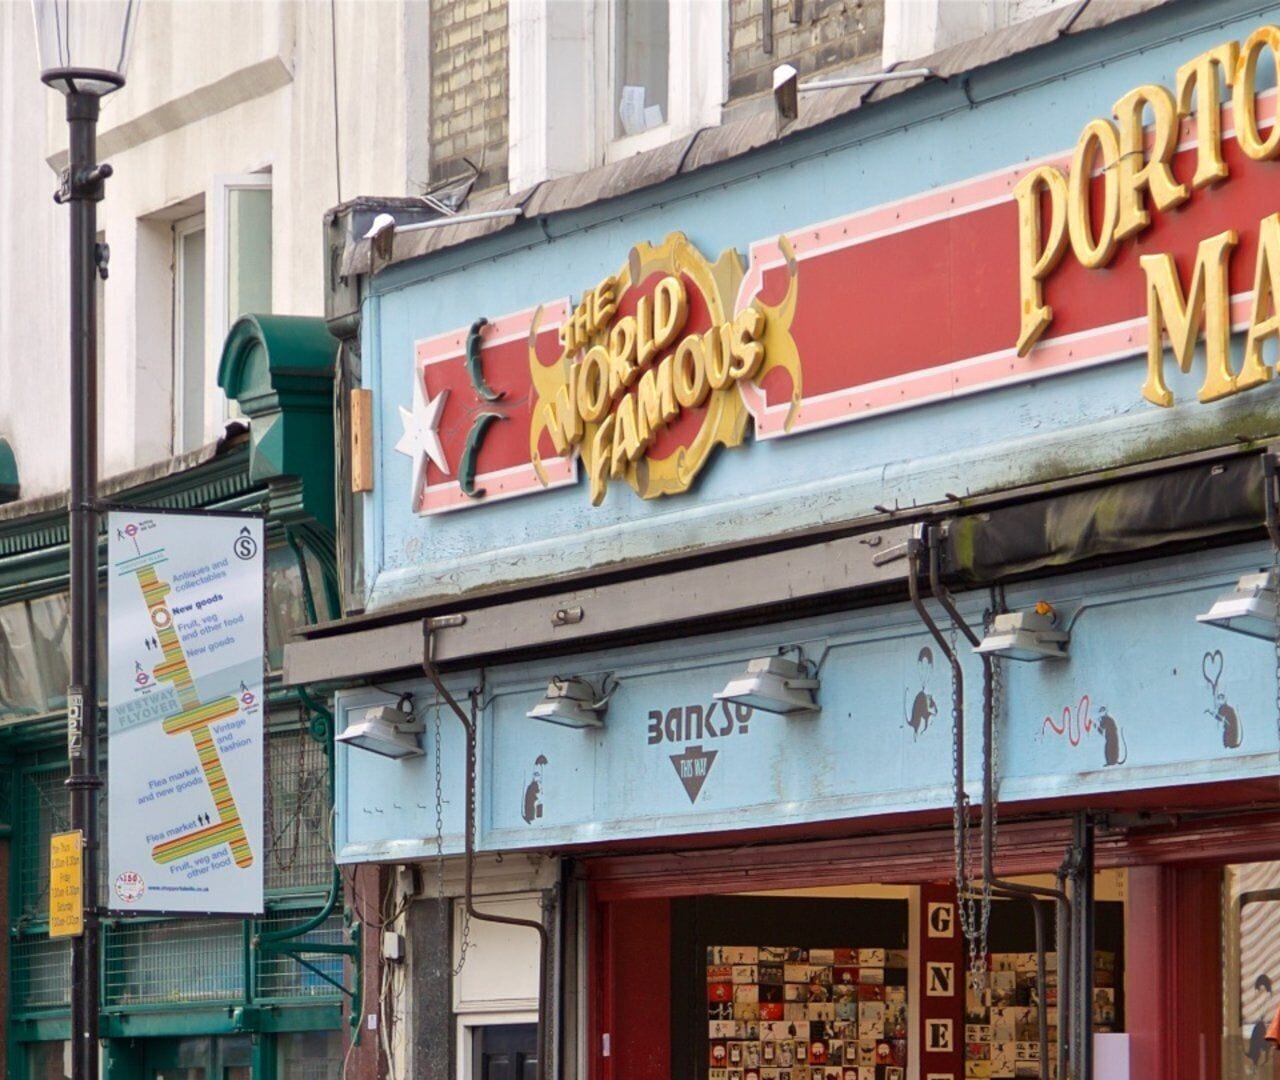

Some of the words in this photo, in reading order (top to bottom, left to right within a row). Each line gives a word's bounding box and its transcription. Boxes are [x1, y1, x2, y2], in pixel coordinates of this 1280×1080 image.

[559, 275, 618, 359] THE
[540, 275, 688, 456] WORLD
[591, 309, 765, 506] FAMOUS
[173, 566, 210, 583] Antiques
[211, 559, 229, 571] and
[175, 571, 227, 593] collectables
[172, 604, 194, 616] New
[195, 594, 224, 610] goods
[182, 628, 199, 642] and
[200, 622, 223, 637] other
[225, 614, 245, 628] food
[203, 614, 218, 625] veg
[187, 646, 206, 658] New
[208, 635, 236, 651] goods
[115, 688, 175, 717] WESTWAY
[120, 700, 178, 727] FLYOVER
[213, 718, 247, 735] Vintage
[647, 698, 754, 745] BANKSY
[217, 733, 234, 745] and
[220, 737, 252, 753] fashion
[148, 777, 168, 789] Flea
[168, 766, 200, 783] market
[680, 759, 693, 777] THIS
[694, 757, 707, 777] WAY
[138, 791, 155, 804] and
[156, 786, 175, 799] new
[176, 777, 204, 793] goods
[146, 832, 165, 844] Flea
[166, 820, 197, 838] market
[186, 865, 211, 879] other
[211, 857, 231, 870] food
[196, 856, 212, 867] veg
[212, 848, 229, 860] and
